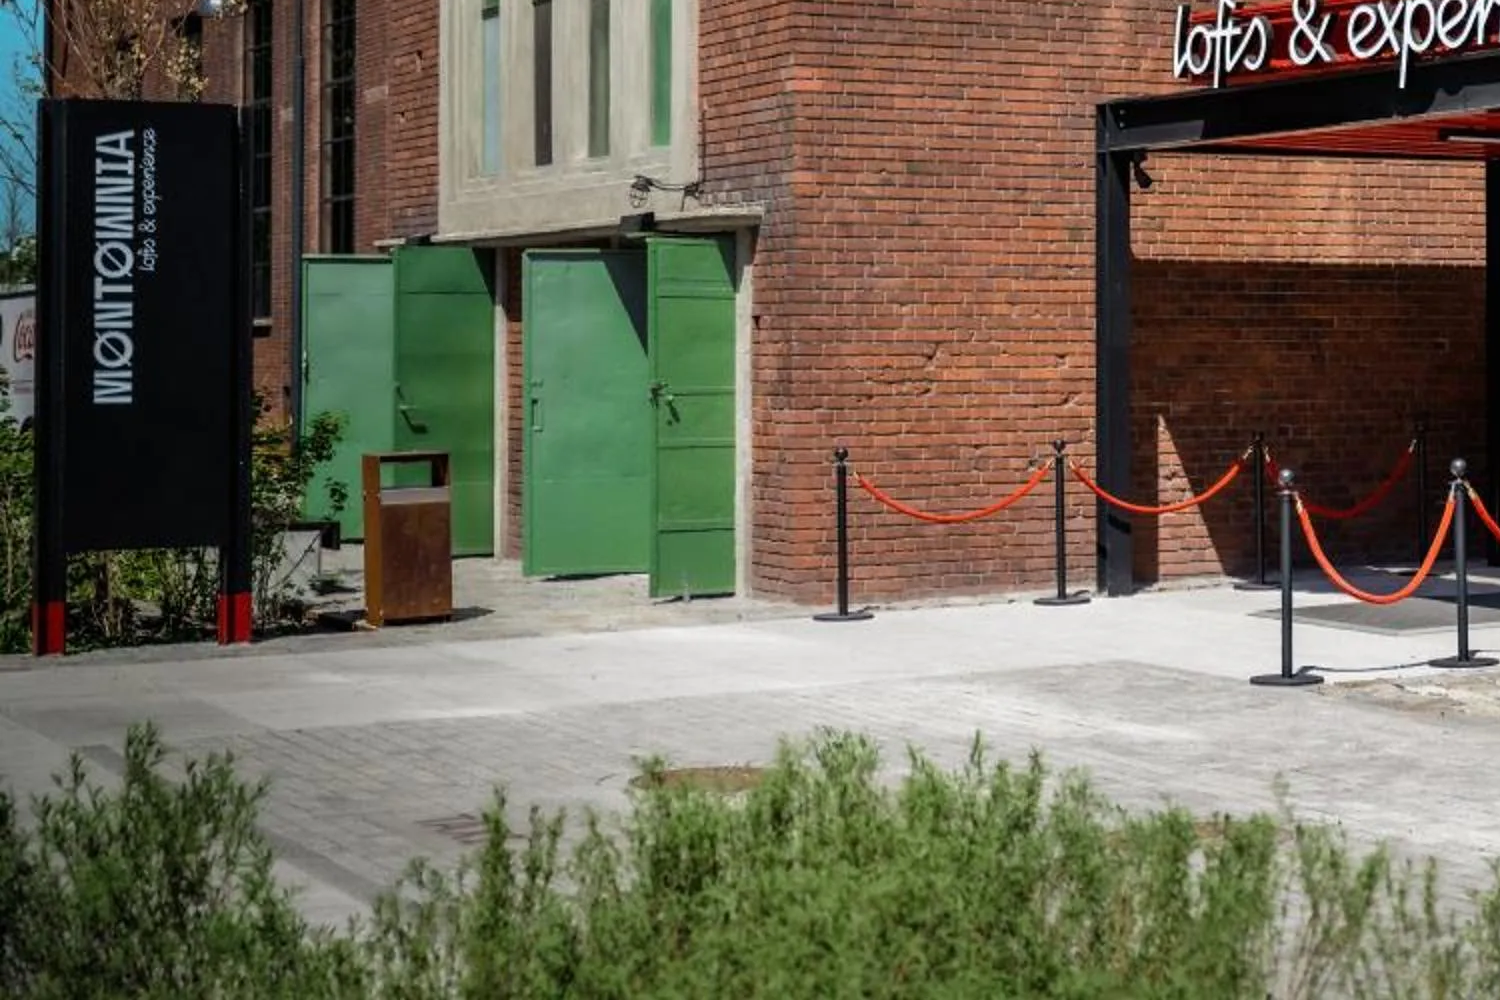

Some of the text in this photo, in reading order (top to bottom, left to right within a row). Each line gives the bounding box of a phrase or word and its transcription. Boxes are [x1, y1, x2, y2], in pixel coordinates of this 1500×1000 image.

[138, 127, 162, 272] lofts & experience
